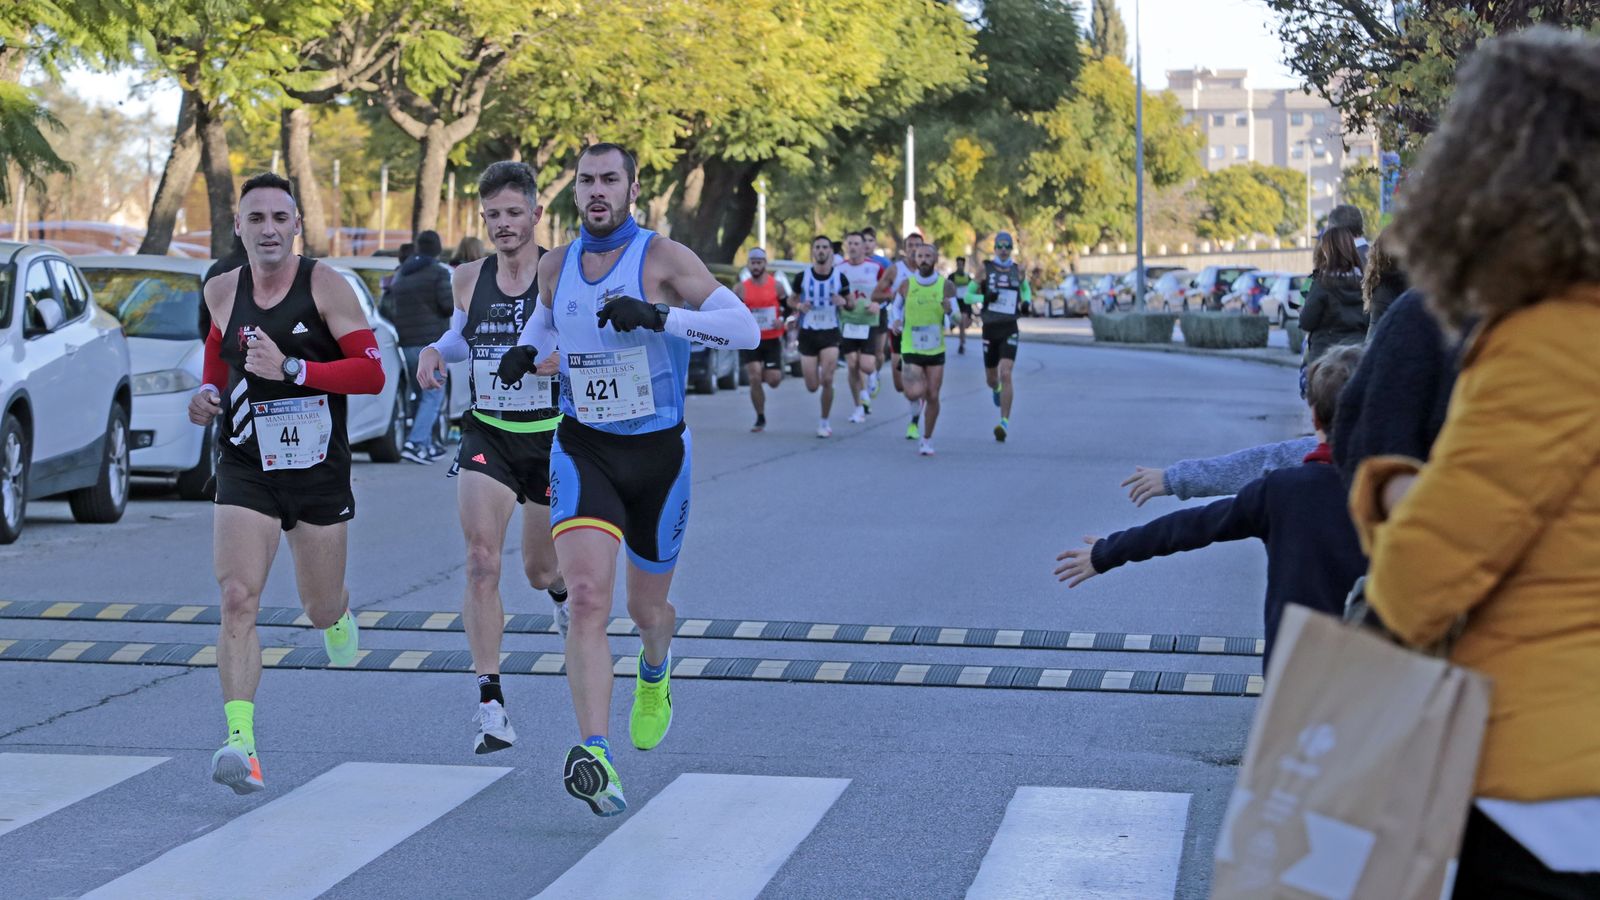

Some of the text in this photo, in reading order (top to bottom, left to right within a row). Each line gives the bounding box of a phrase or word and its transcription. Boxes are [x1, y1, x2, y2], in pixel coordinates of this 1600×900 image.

[686, 328, 730, 347] #Sevilla10
[476, 348, 490, 358] XXV
[569, 355, 581, 366] XXV
[579, 362, 635, 375] MANUEL JESÚS
[585, 378, 619, 401] 421
[265, 414, 294, 423] MANUEL
[280, 425, 300, 447] 44
[671, 499, 689, 541] Viso
